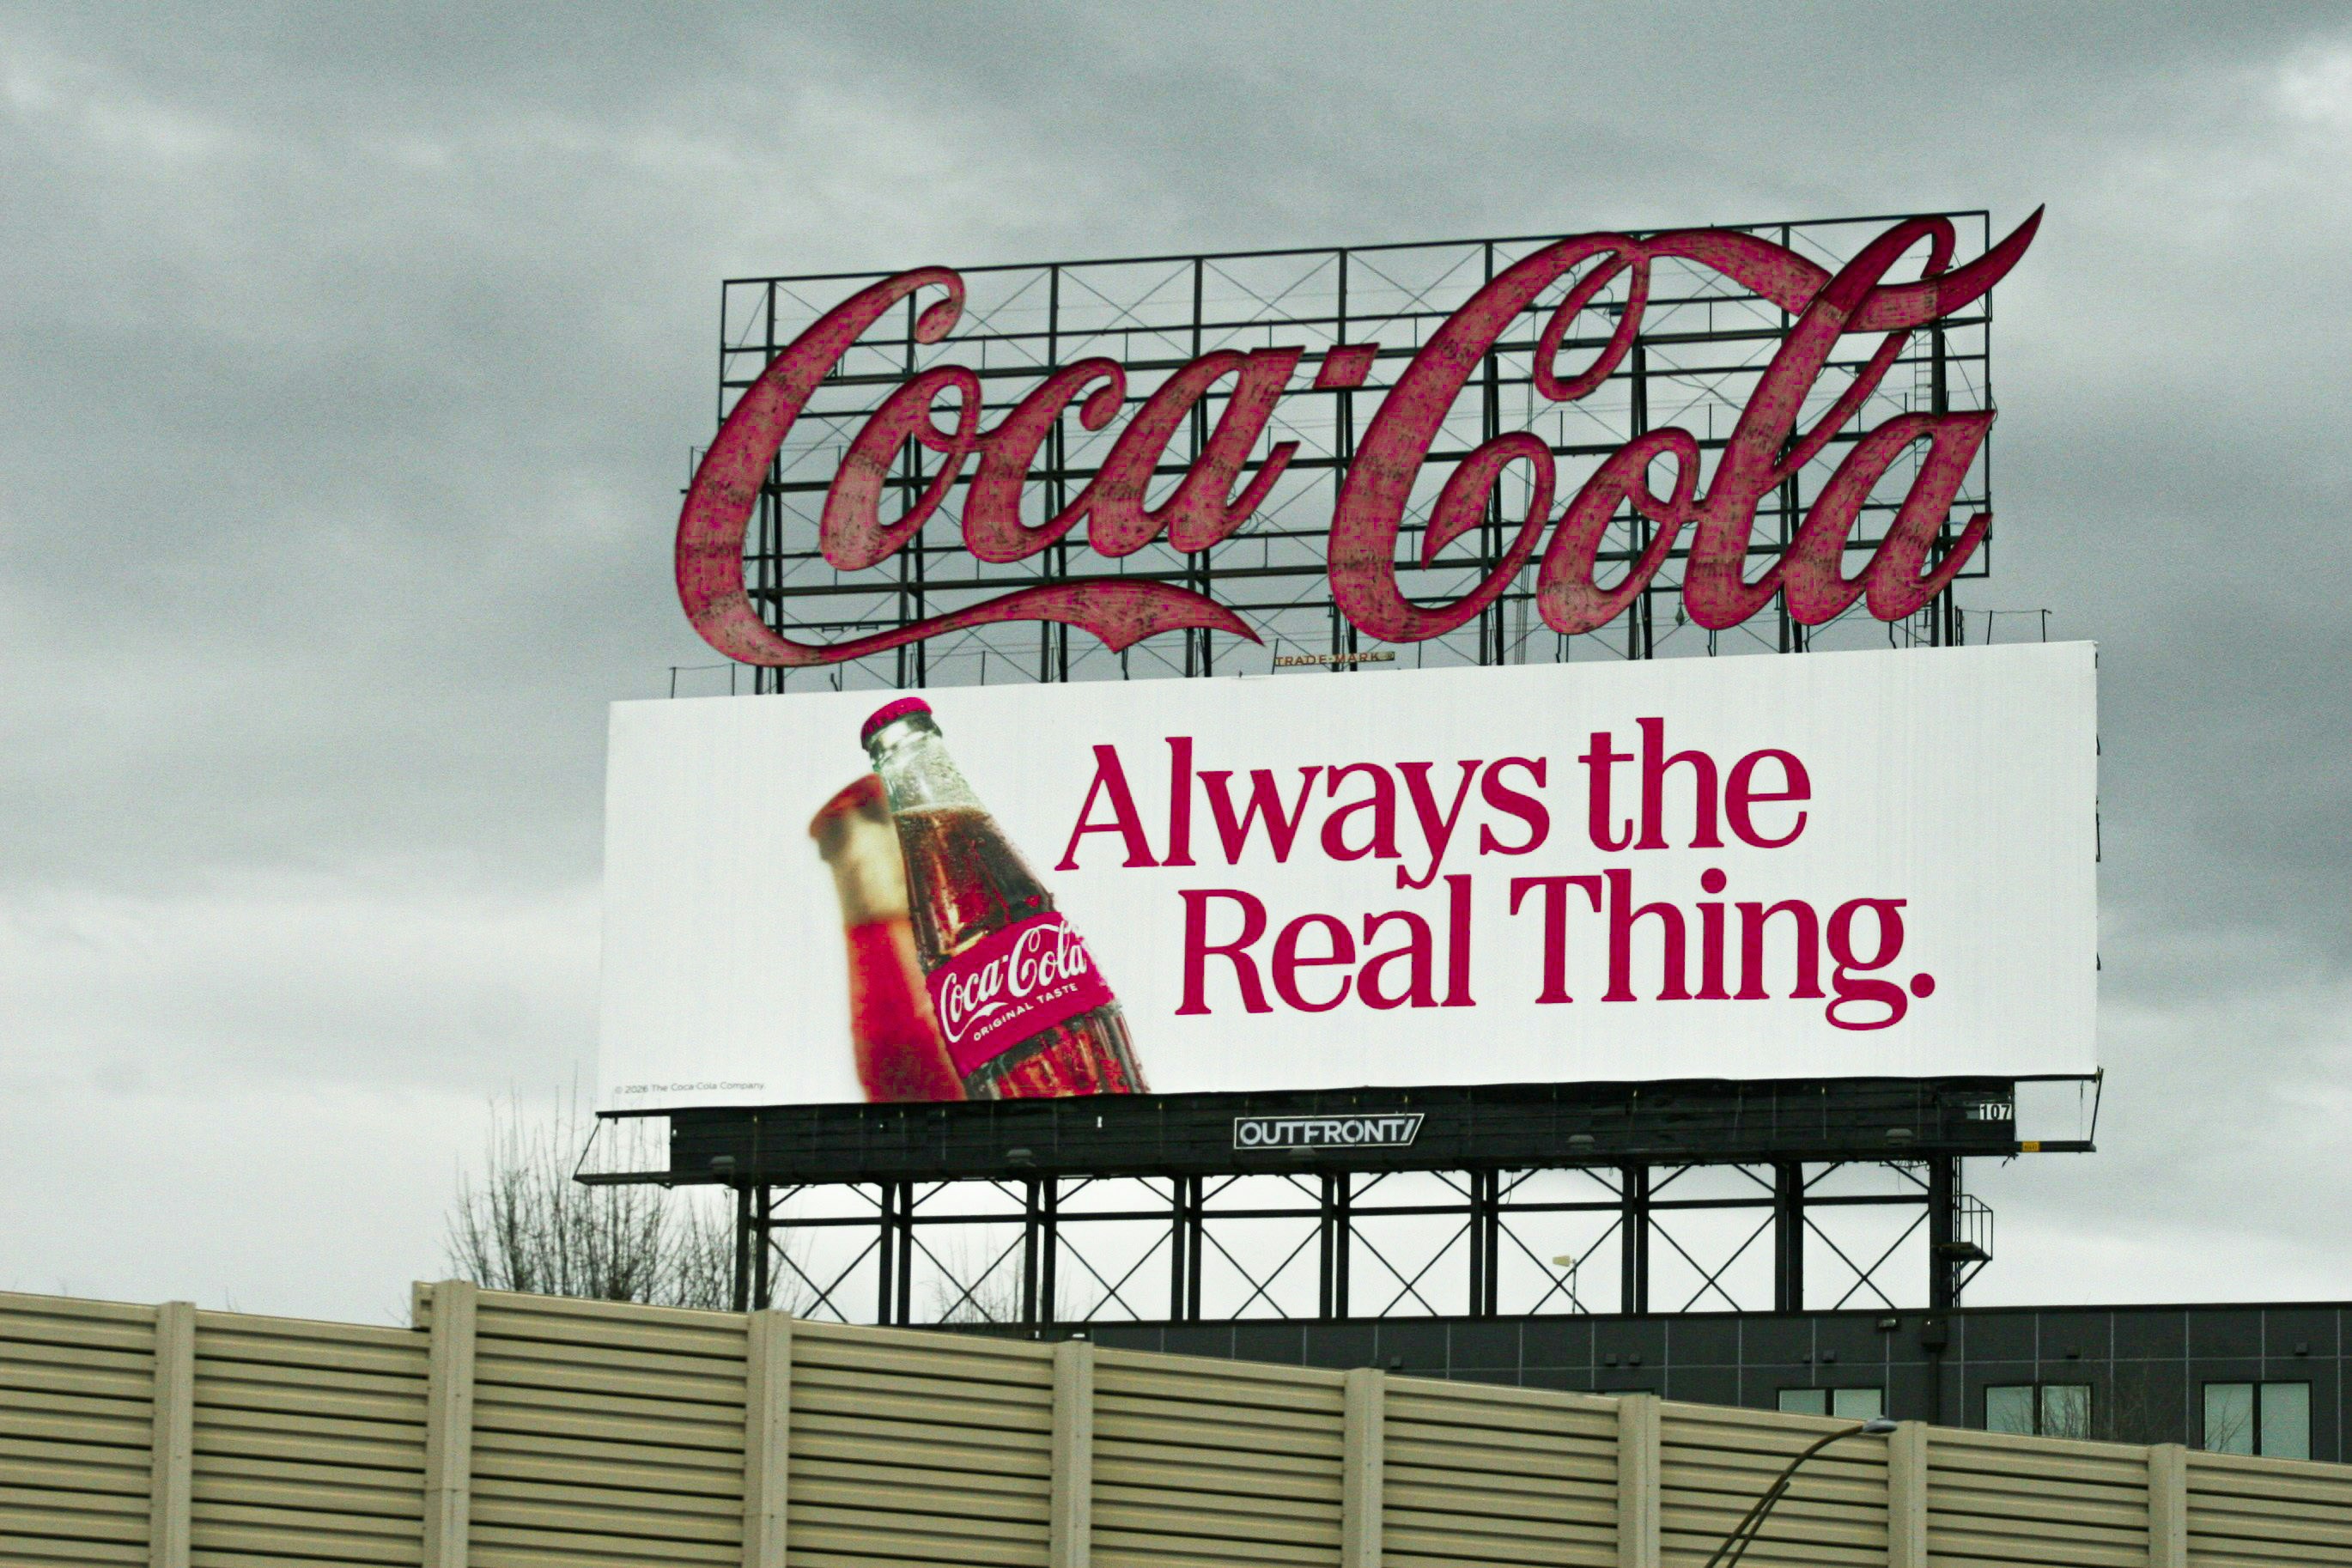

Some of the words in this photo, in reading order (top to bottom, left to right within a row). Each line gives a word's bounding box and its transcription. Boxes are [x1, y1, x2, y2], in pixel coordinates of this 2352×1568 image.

[675, 202, 2045, 667] Coca-Cola
[1275, 652, 1380, 666] TRADE-MARK
[1054, 736, 1550, 890] Always
[1577, 717, 1811, 851] the
[940, 921, 1088, 1043] Coca-Cola
[1175, 874, 1477, 1015] Real
[1510, 867, 1936, 1030] Thing.
[973, 1002, 1035, 1042] ORIGINAL
[1036, 982, 1079, 1005] TASTE
[624, 1085, 649, 1094] 2026
[651, 1084, 667, 1092] The
[1980, 1103, 2011, 1120] 107
